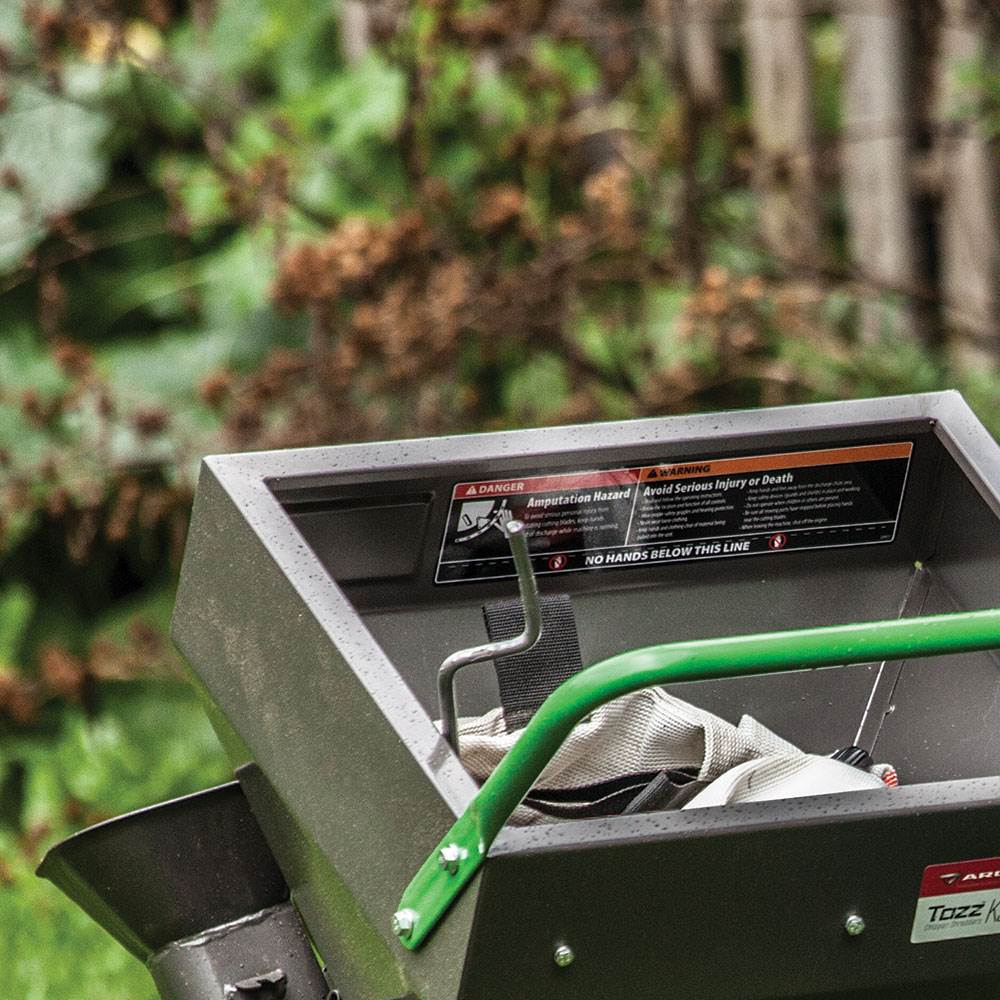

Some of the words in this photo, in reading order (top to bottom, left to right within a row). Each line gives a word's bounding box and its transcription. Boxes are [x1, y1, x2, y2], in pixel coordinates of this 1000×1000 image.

[660, 465, 711, 476] WARNING
[479, 482, 525, 494] DANGER
[643, 484, 673, 496] Avoid
[674, 482, 713, 494] Serious
[715, 478, 747, 490] Injury
[748, 478, 760, 486] or
[762, 472, 794, 484] Death
[527, 494, 591, 509] Amputation
[593, 488, 631, 501] Hazard
[585, 555, 603, 565] NO
[605, 551, 648, 563] HANDS
[650, 547, 692, 559] BELOW
[694, 544, 721, 556] THIS
[723, 541, 750, 553] LINE
[928, 903, 986, 922] Tazz
